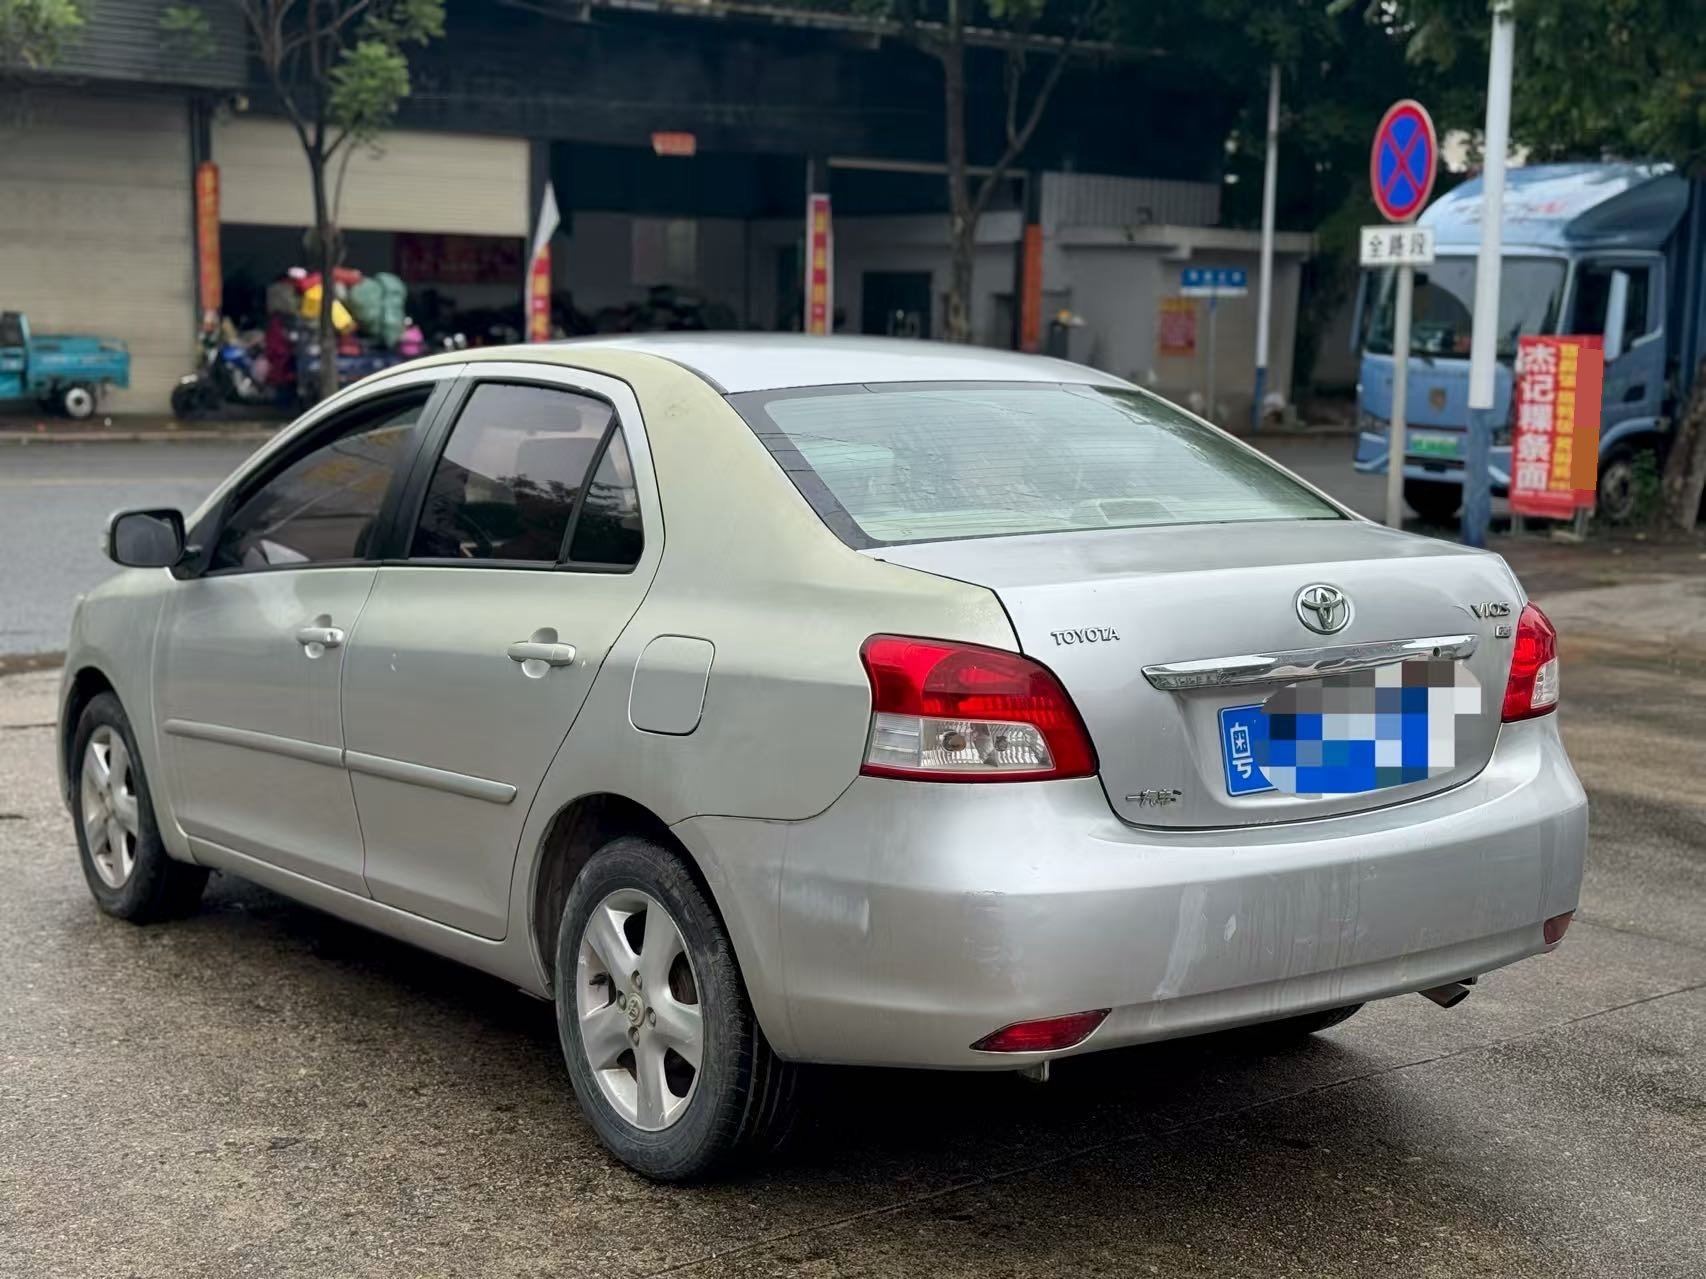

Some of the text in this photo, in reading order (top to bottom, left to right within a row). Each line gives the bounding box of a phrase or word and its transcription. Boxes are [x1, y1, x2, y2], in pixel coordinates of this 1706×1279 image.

[1368, 231, 1425, 258] 全路段
[1470, 601, 1511, 619] VIOS
[1050, 625, 1120, 646] TOYOTA
[1229, 721, 1254, 779] 粤
